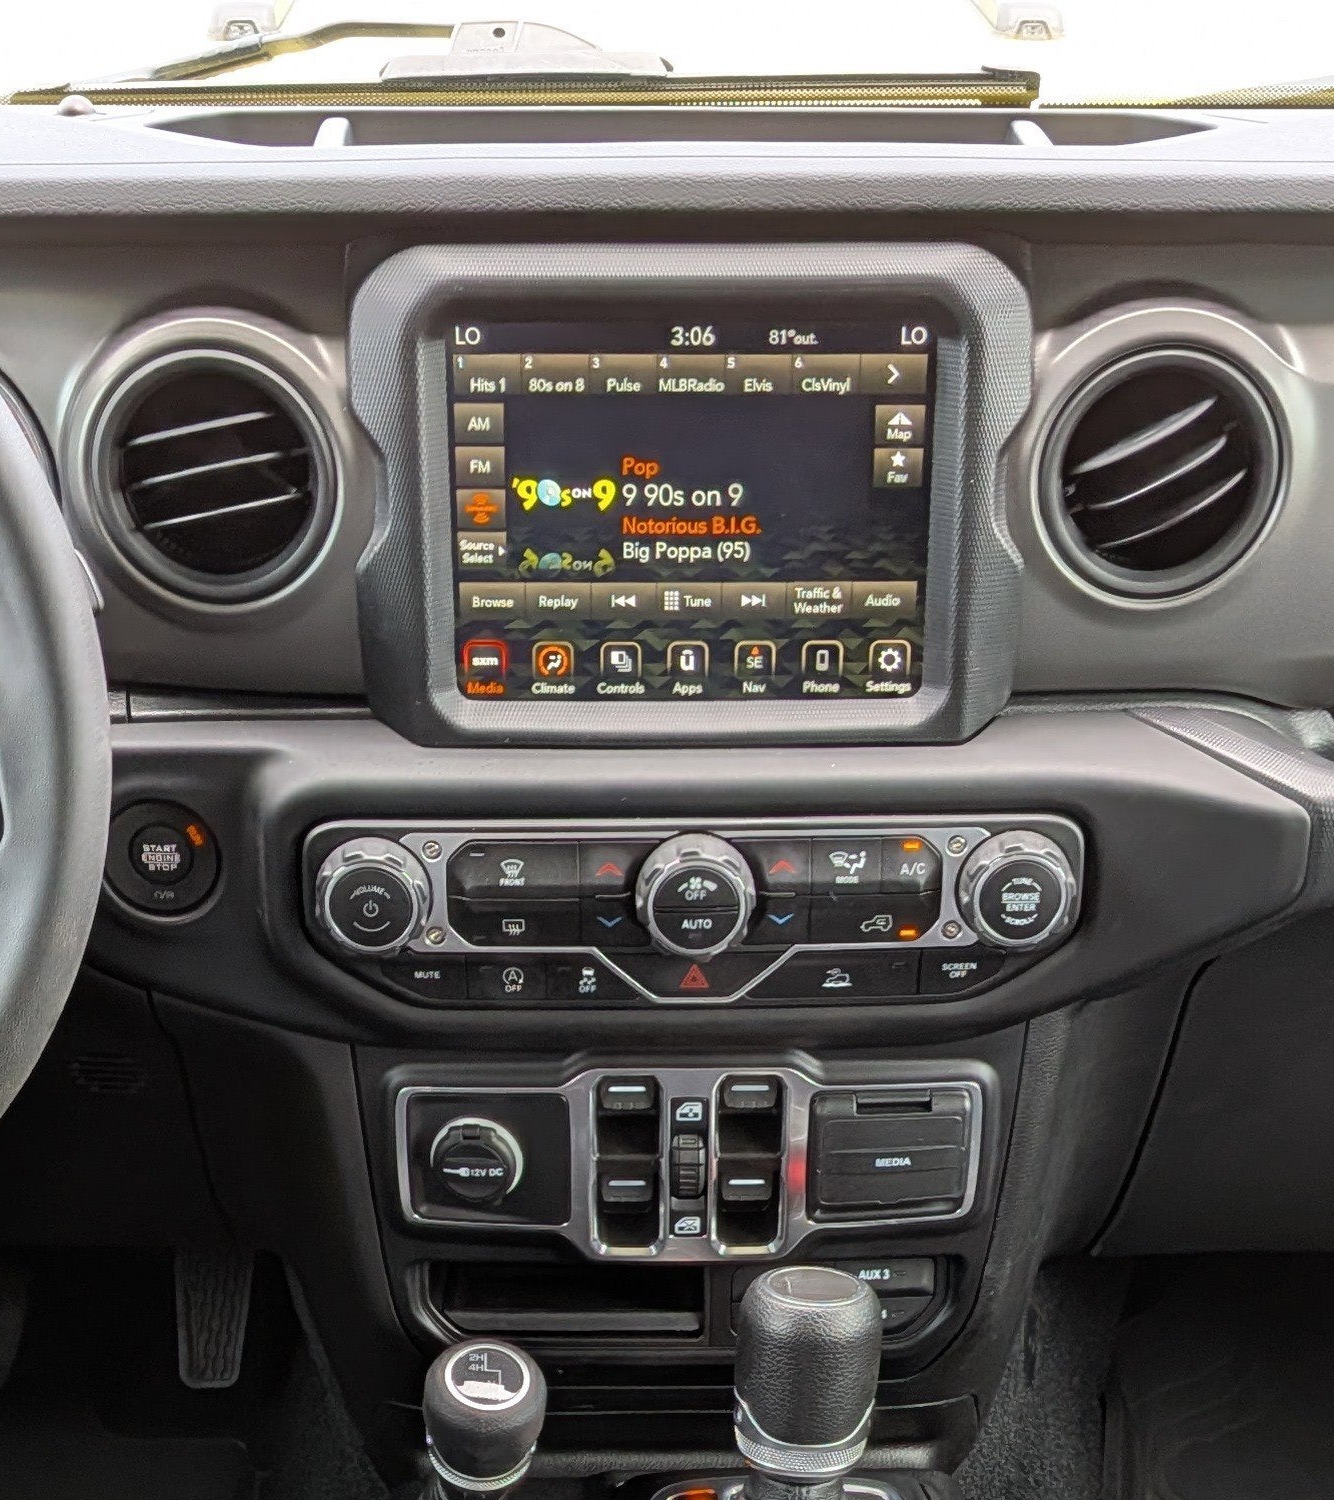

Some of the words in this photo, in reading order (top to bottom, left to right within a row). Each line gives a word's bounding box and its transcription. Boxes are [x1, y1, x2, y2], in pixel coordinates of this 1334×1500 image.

[455, 326, 481, 345] LO
[670, 326, 715, 346] 3:06
[901, 326, 927, 345] LO
[456, 356, 464, 369] 1
[524, 356, 533, 369] 2
[592, 356, 600, 369] 3
[659, 356, 668, 369] 4
[727, 356, 735, 369] 5
[794, 356, 803, 369] 6
[469, 378, 496, 393] Hits
[499, 378, 506, 392] 1
[528, 378, 553, 392] 80s
[555, 381, 573, 392] on
[575, 378, 585, 392] 8
[606, 378, 641, 393] Pulse
[658, 378, 725, 393] MLBRadio
[743, 378, 773, 393] Elvis
[801, 376, 851, 395] ClsVinyl
[467, 416, 490, 432] AM
[886, 428, 912, 442] Map
[469, 460, 491, 474] FM
[621, 457, 659, 479] Pop
[886, 471, 908, 484] Fav
[592, 478, 616, 512] 9
[622, 483, 637, 506] 9
[644, 483, 684, 507] 90s
[691, 490, 722, 507] on
[728, 483, 744, 507] 9
[622, 516, 707, 536] Notorious
[712, 516, 763, 536] B.I.G.
[458, 539, 495, 551] Source
[461, 553, 494, 564] Select
[623, 541, 650, 563] Big
[655, 542, 713, 563] Poppa
[717, 541, 751, 563] (95)
[794, 586, 830, 599] Traffic
[832, 587, 842, 599] &
[471, 595, 515, 608] Browse
[538, 595, 579, 610] Replay
[684, 595, 712, 608] Tune
[865, 593, 901, 608] Audio
[794, 601, 844, 615] Weather
[471, 655, 499, 666] sxm
[746, 656, 764, 669] SE
[468, 681, 504, 695] Media
[531, 681, 576, 695] Climate
[596, 681, 645, 695] Controls
[672, 682, 703, 697] Apps
[742, 681, 767, 694] Nav
[802, 680, 841, 694] Phone
[865, 680, 912, 695] Settings
[142, 843, 178, 853] START
[148, 863, 178, 872] STOP
[899, 862, 926, 876] A/C
[684, 890, 707, 901] OFF
[1001, 892, 1041, 901] BROWSE
[1005, 902, 1036, 912] ENTER
[681, 918, 713, 930] AUTO
[941, 961, 978, 972] SCREEN
[414, 970, 441, 980] MUTE
[949, 970, 967, 979] OFF
[504, 983, 523, 993] OFF
[578, 984, 597, 994] OFF
[874, 1156, 912, 1168] MEDIA
[471, 1167, 488, 1178] 12V
[489, 1167, 504, 1177] DC
[857, 1269, 881, 1280] AUX
[882, 1268, 890, 1280] 3
[468, 1353, 484, 1362] 2H
[468, 1363, 484, 1372] 4H
